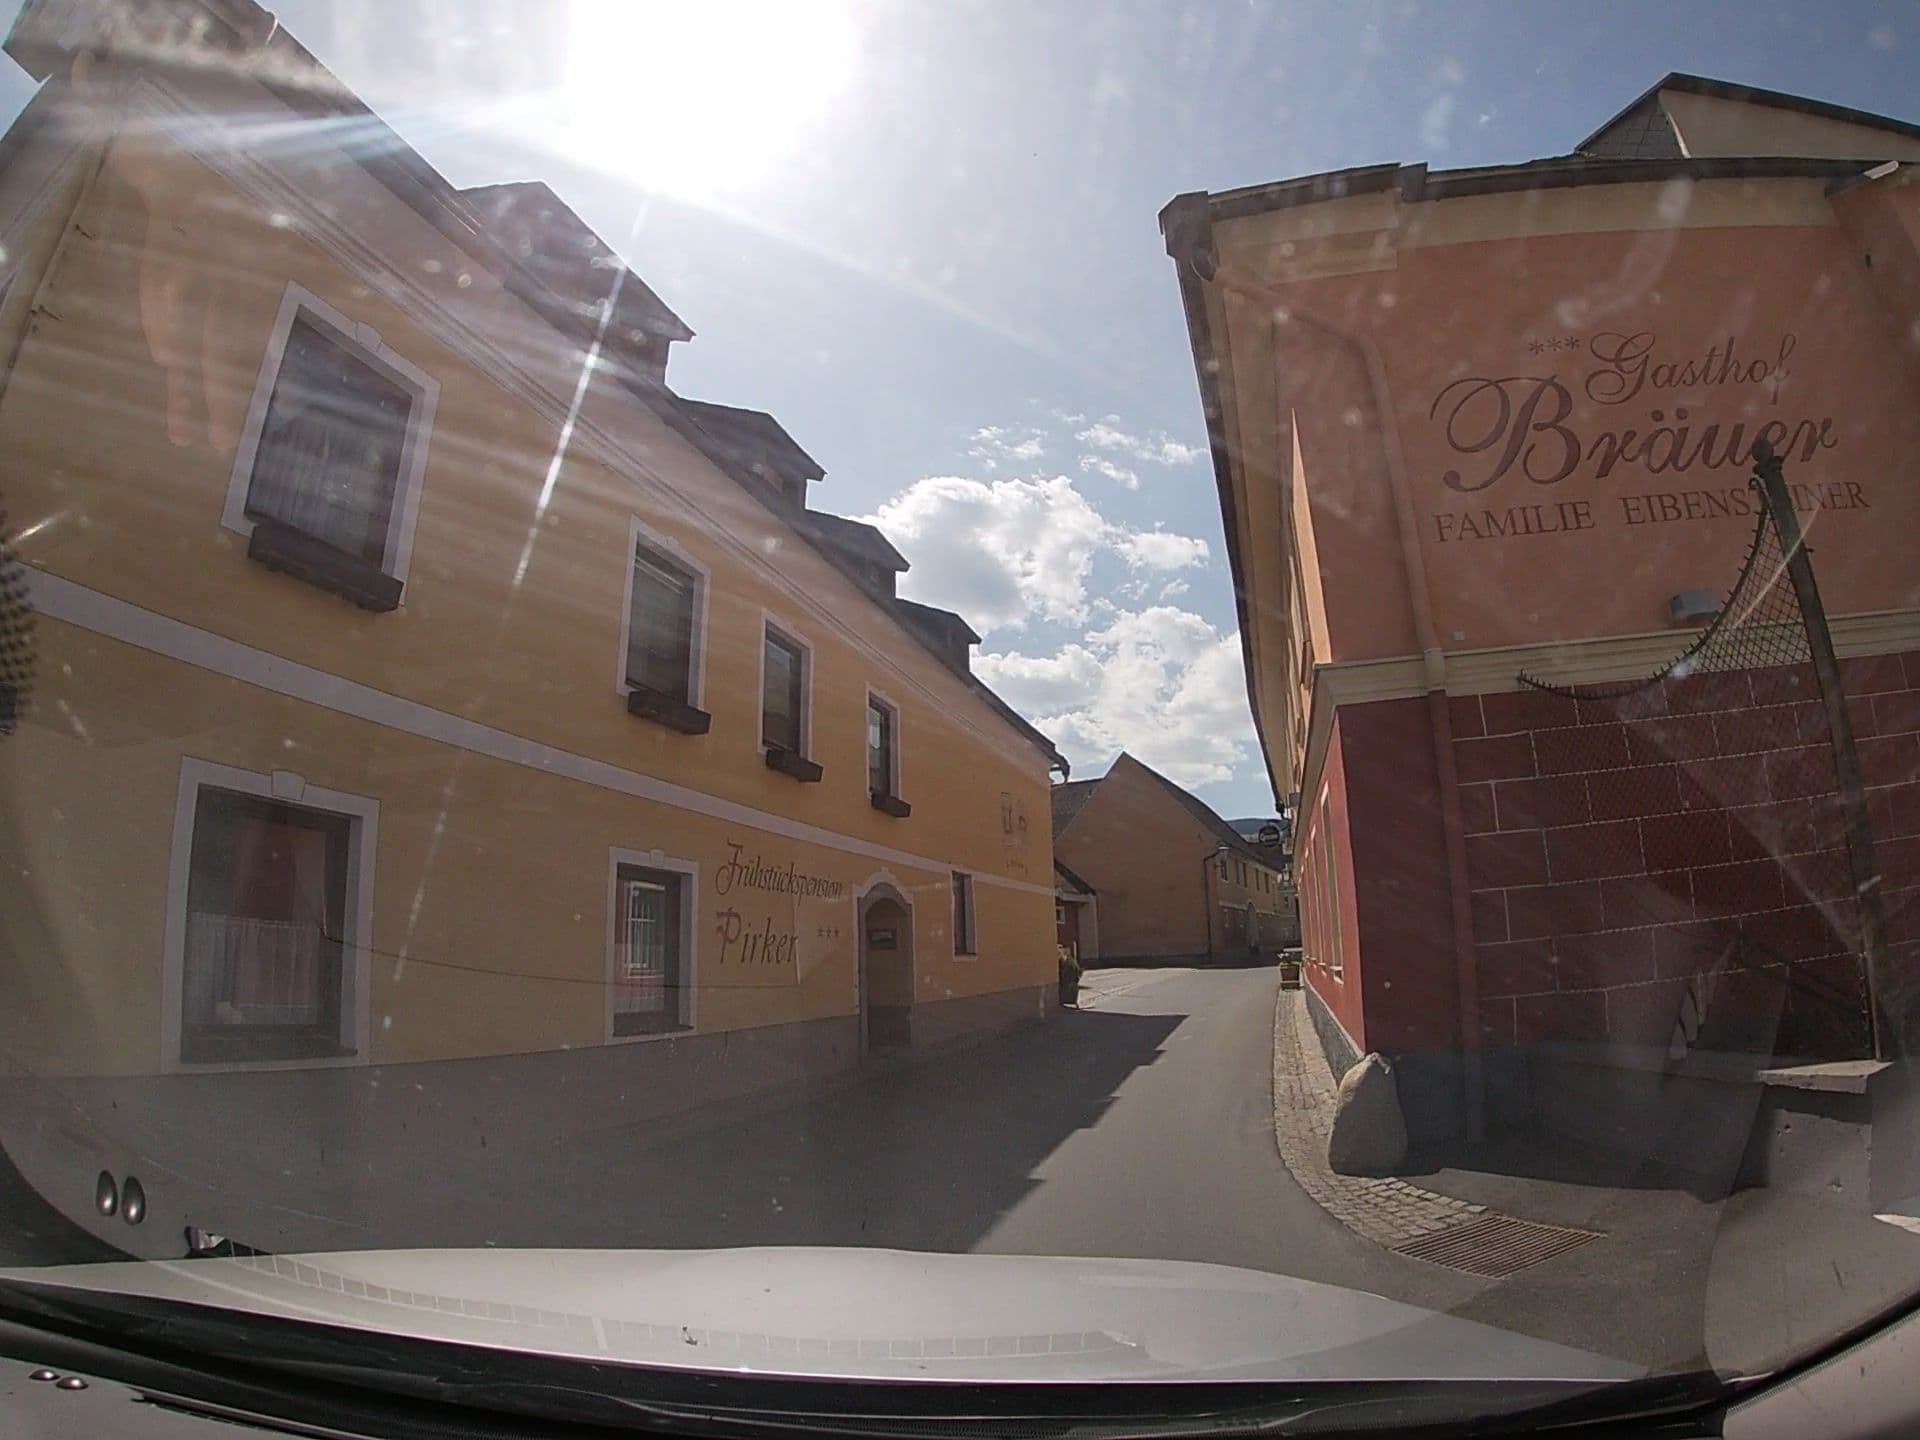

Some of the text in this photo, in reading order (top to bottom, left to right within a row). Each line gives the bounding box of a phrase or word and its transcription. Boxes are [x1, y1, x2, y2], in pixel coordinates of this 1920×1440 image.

[1585, 331, 1797, 406] Gasthof
[1430, 374, 1838, 492] Bräuer
[1433, 480, 1871, 543] FAMILIE EIBENSINER
[716, 906, 799, 964] Pirker
